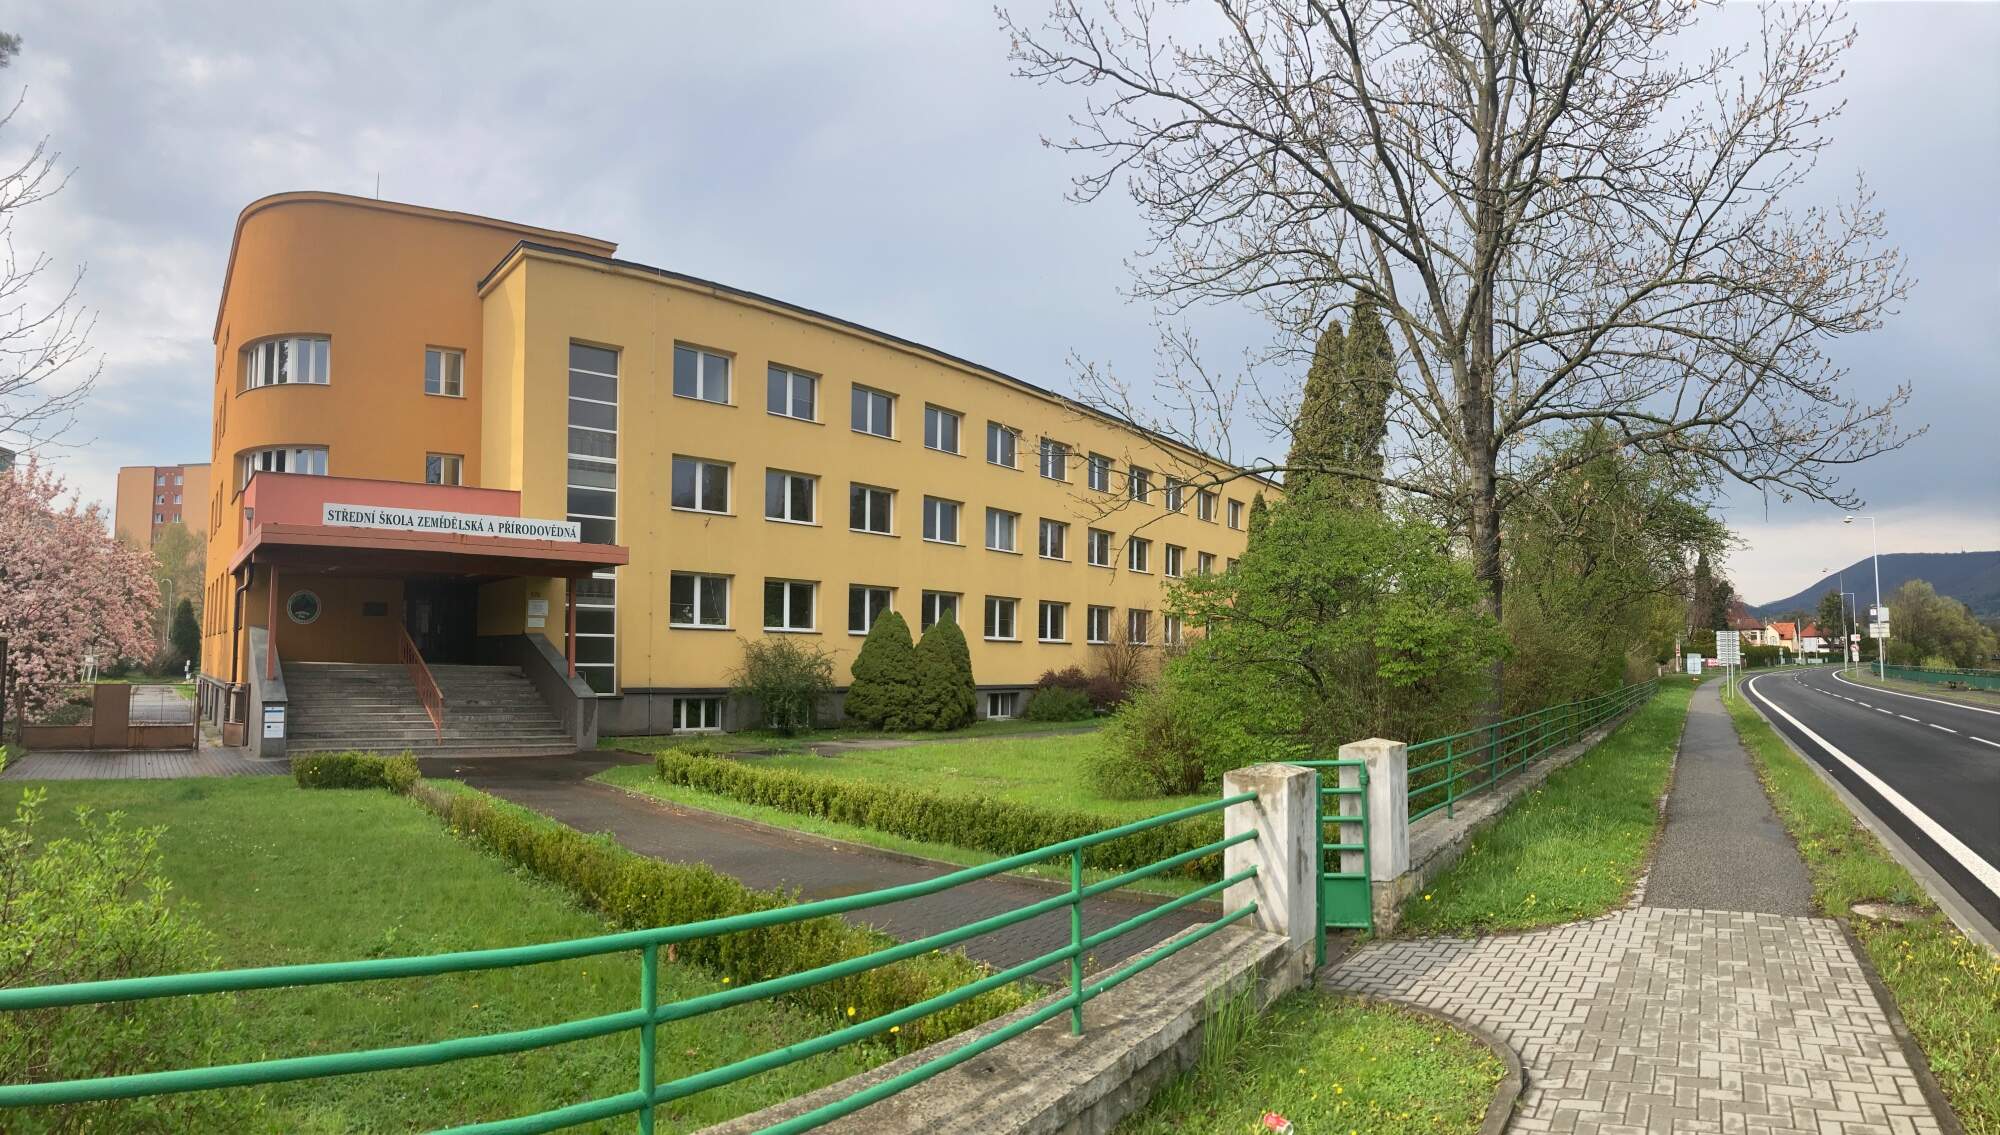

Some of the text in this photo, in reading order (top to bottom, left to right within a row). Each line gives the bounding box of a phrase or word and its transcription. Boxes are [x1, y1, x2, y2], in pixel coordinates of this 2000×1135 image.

[328, 508, 375, 524] STŘEDNÍ
[378, 511, 414, 526] ŠKOLA
[487, 522, 495, 533] A
[498, 520, 577, 538] PŘÍRODOVĚDNÁ
